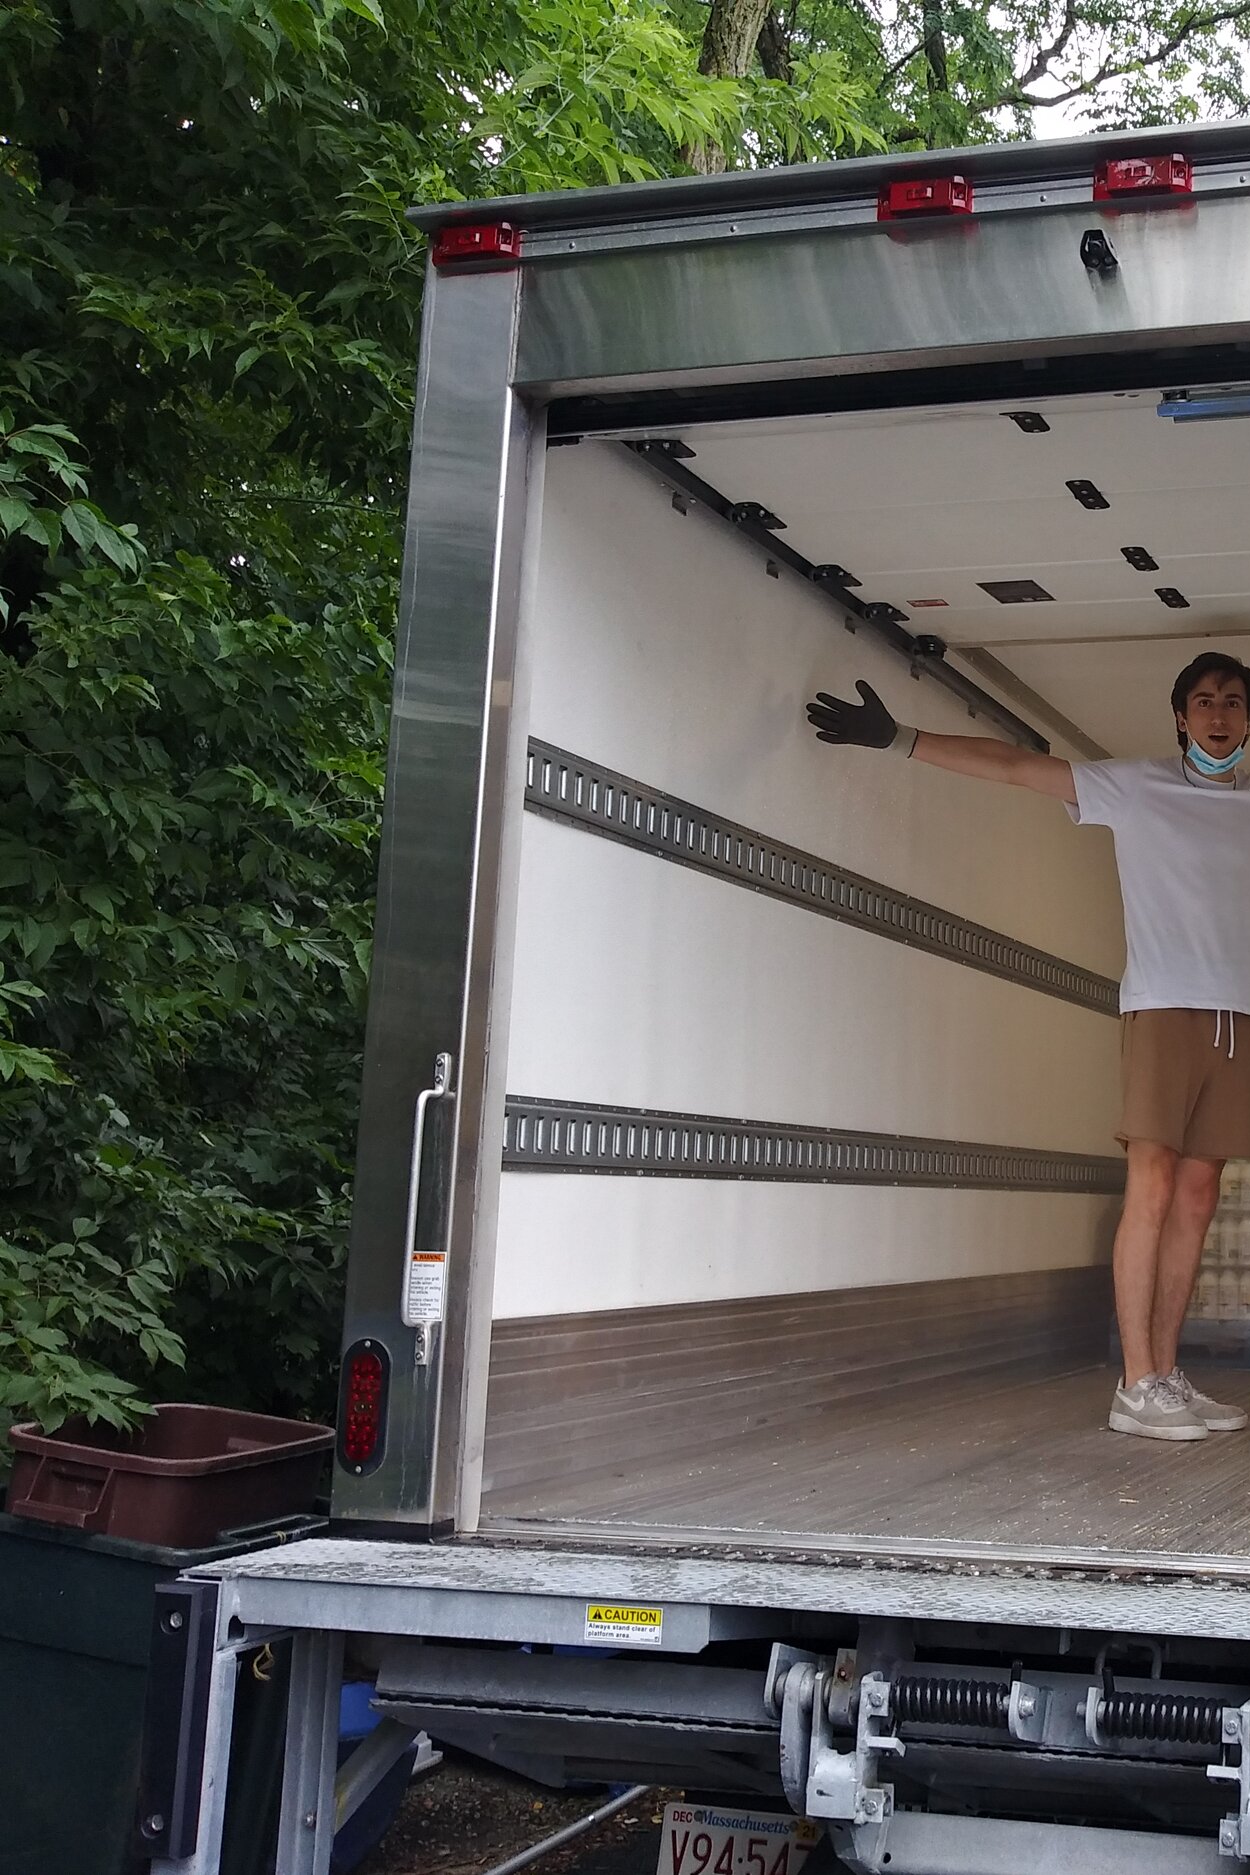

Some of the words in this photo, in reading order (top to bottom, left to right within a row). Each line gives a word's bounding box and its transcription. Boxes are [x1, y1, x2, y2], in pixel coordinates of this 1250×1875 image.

[604, 1609, 657, 1623] CAUTION
[673, 1810, 693, 1823] DEC
[701, 1810, 790, 1835] Massachusetts
[802, 1825, 816, 1839] 21
